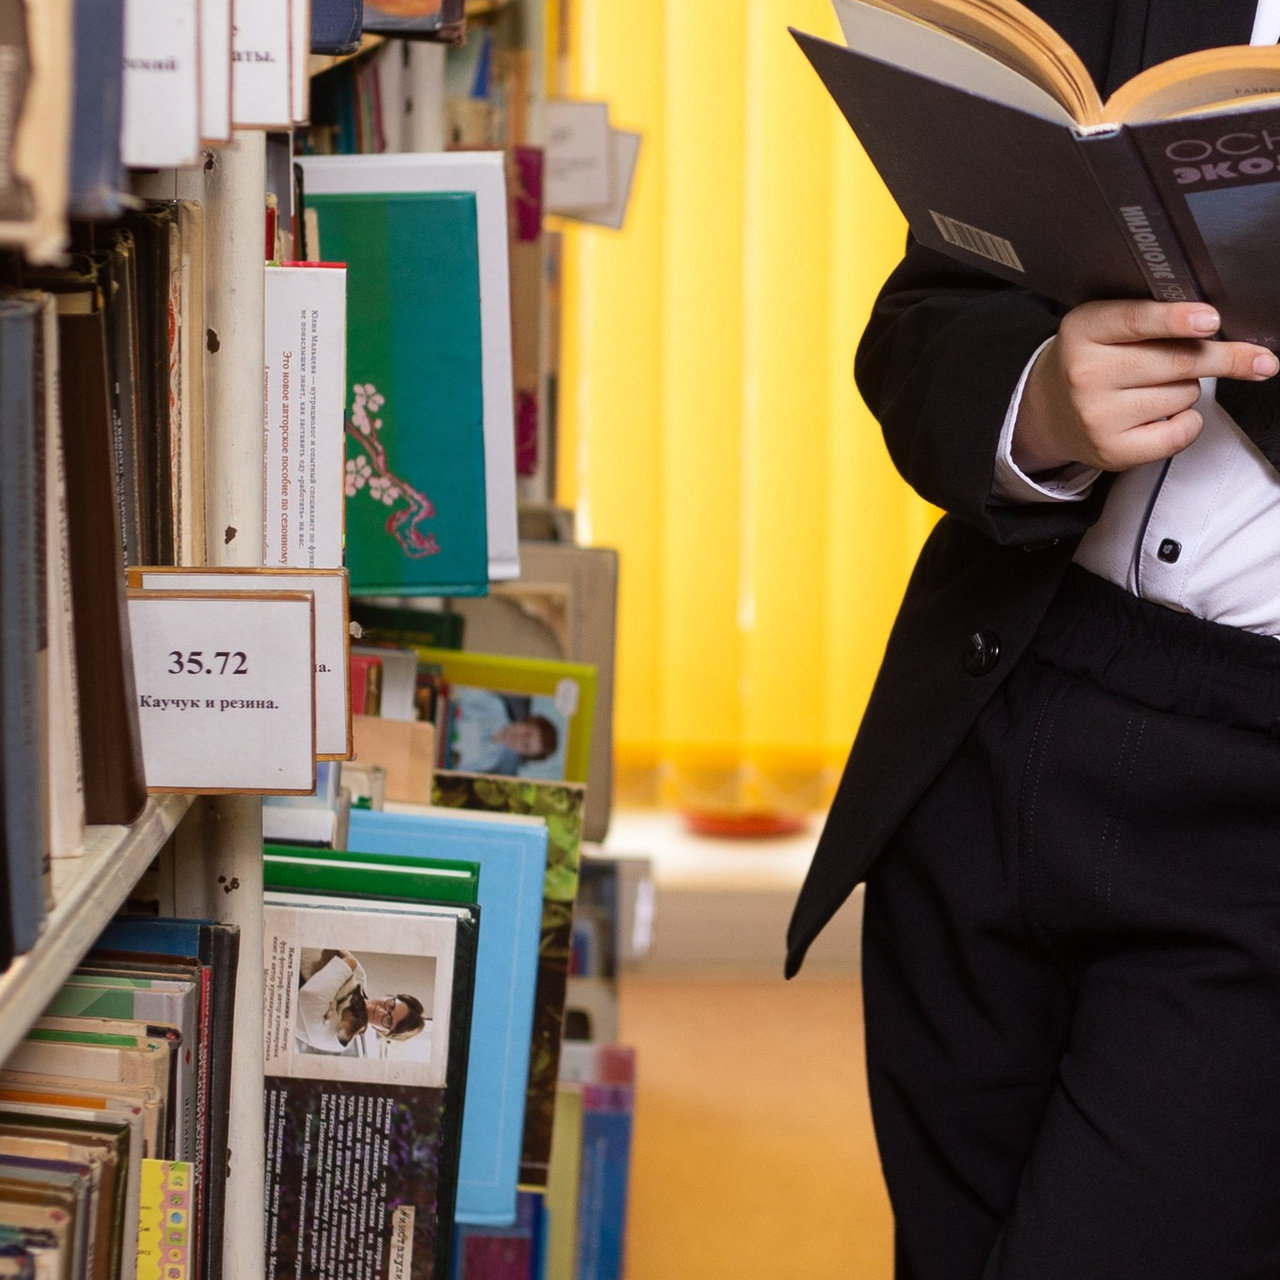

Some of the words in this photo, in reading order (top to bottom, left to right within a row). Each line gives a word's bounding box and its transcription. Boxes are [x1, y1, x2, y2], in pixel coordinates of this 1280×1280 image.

[1119, 205, 1176, 279] ЭКОЛОГИИ
[281, 351, 291, 369] Это
[281, 372, 291, 401] новое
[280, 403, 291, 453] авторское
[280, 456, 290, 496] пособие
[280, 498, 290, 510] по
[280, 513, 290, 565] сезонному
[167, 651, 249, 675] 35.72
[139, 695, 200, 711] Каучук
[205, 700, 215, 708] и
[220, 698, 279, 712] резина.
